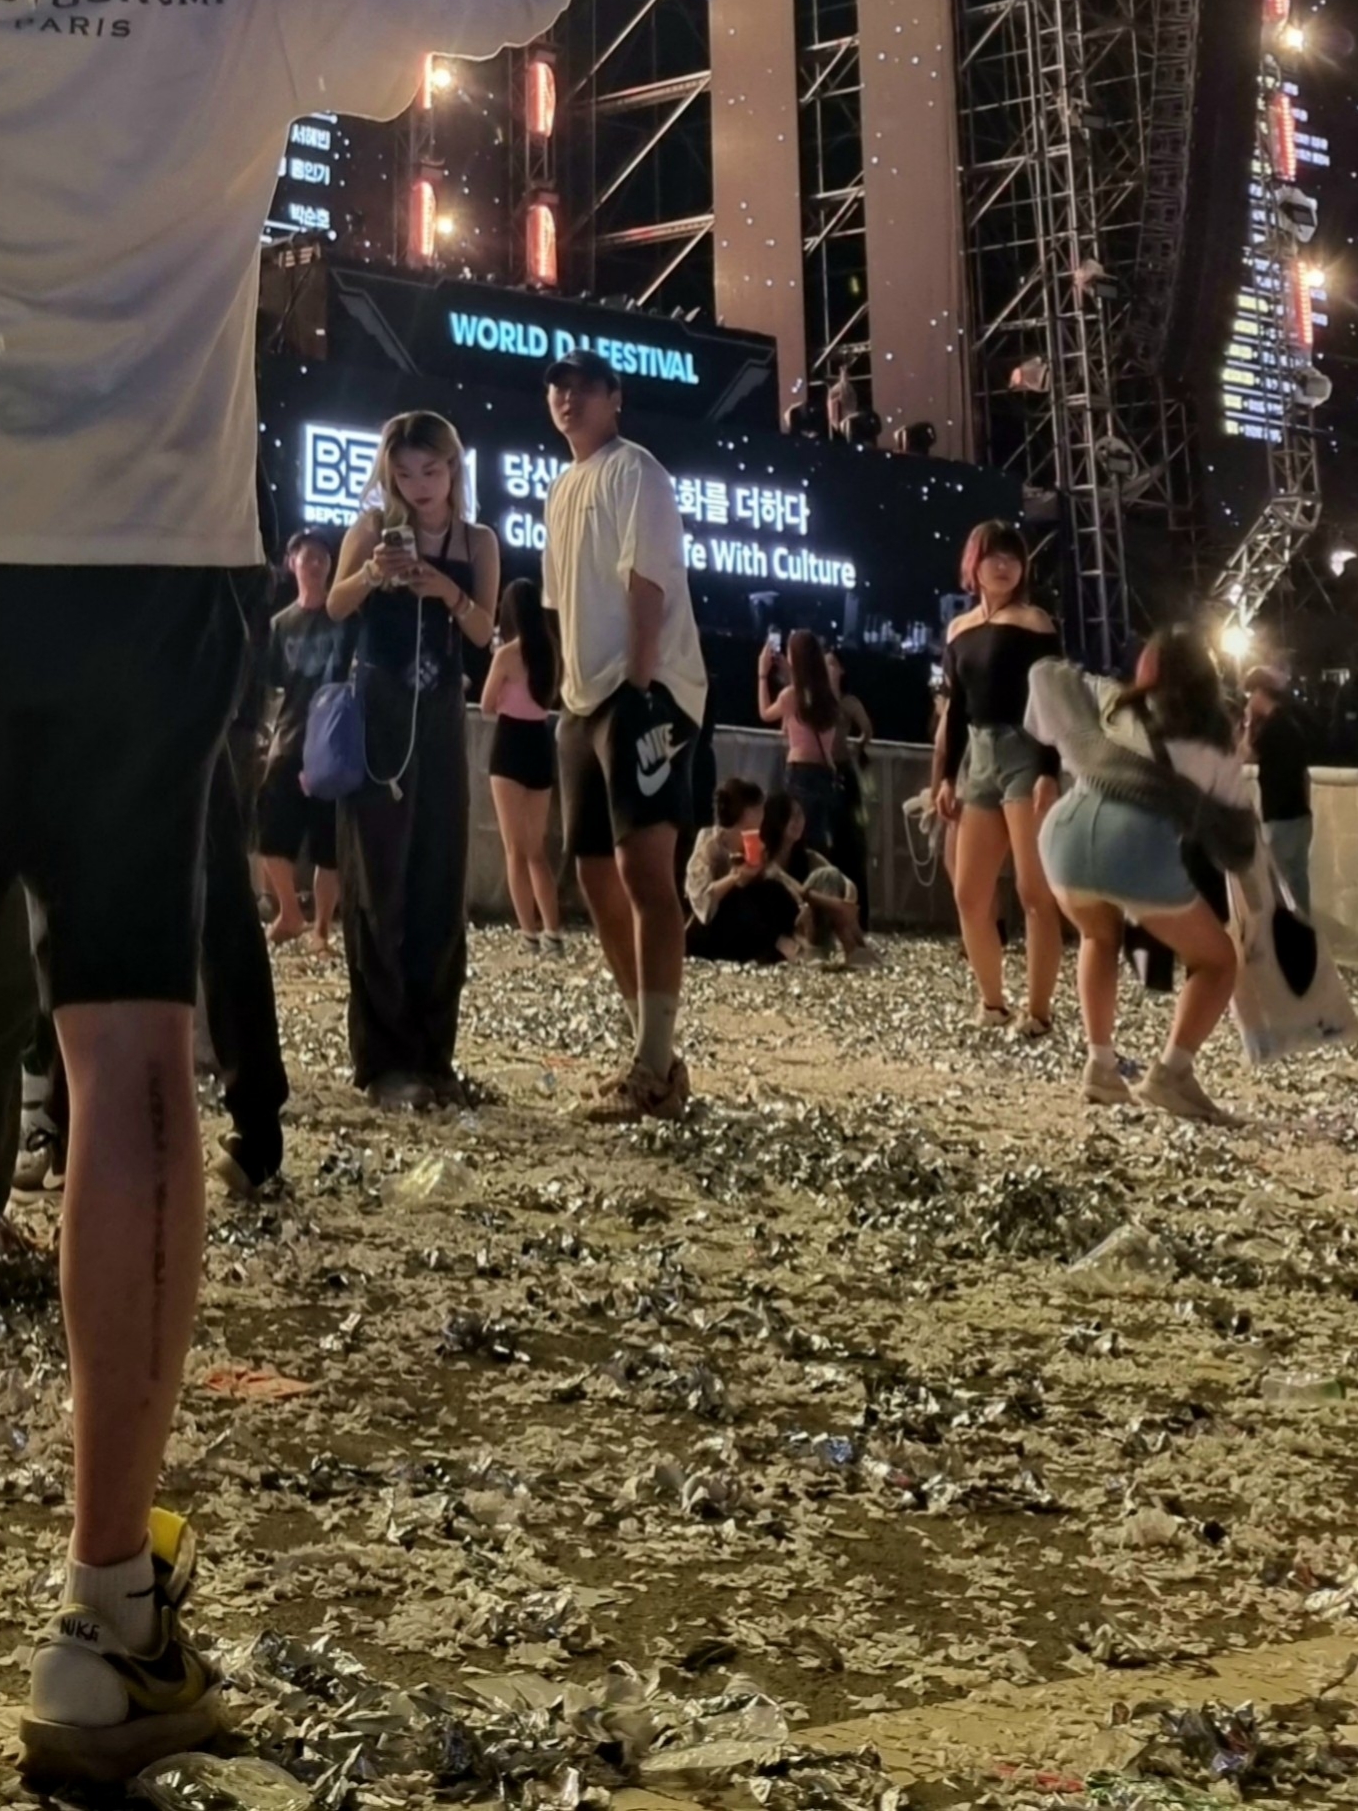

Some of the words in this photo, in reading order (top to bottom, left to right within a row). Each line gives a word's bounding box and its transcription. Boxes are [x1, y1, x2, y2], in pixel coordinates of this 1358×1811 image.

[449, 312, 548, 358] WORLD
[596, 337, 699, 385] FESTIVAL
[670, 475, 730, 525] 화를
[736, 486, 810, 536] 더하다
[711, 539, 768, 579] With
[773, 546, 857, 589] Culture
[60, 1617, 100, 1644] NIKE
